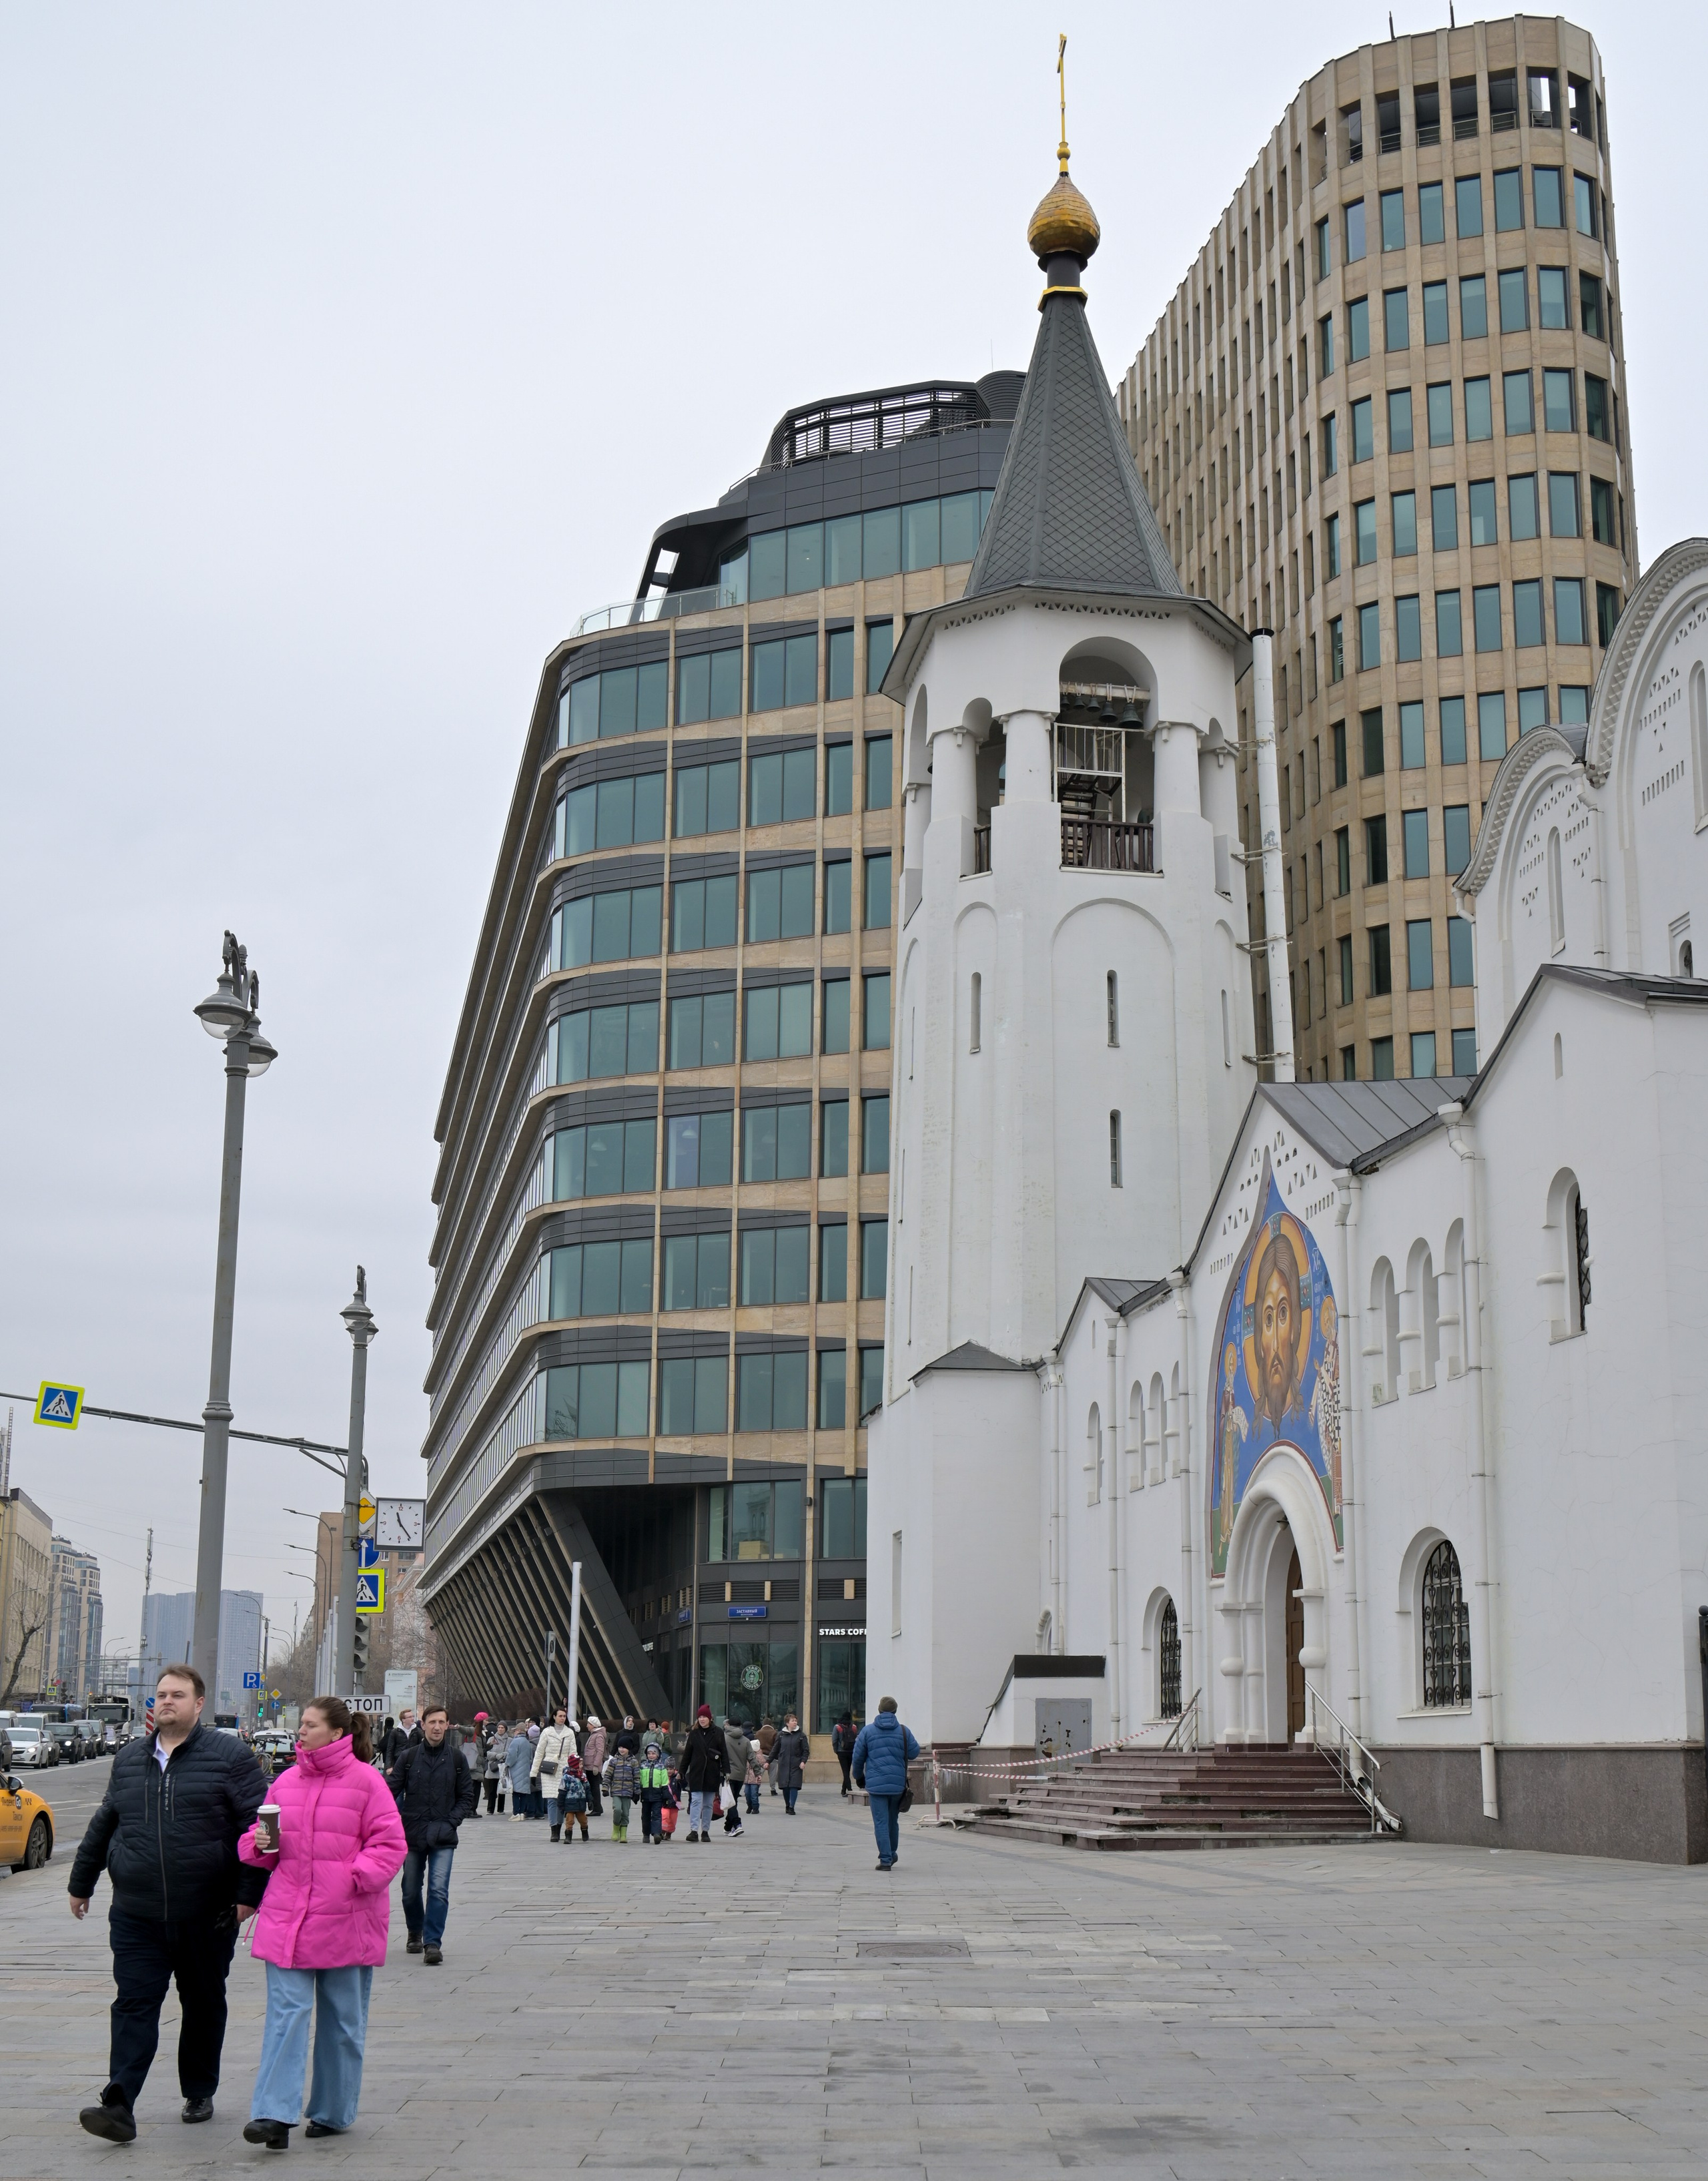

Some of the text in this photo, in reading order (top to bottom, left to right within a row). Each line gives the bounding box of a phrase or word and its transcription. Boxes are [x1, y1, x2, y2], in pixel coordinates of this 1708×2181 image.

[247, 1674, 257, 1686] P
[744, 1681, 759, 1689] COFFEE
[16, 1797, 21, 1807] Go
[13, 1811, 23, 1821] Такси
